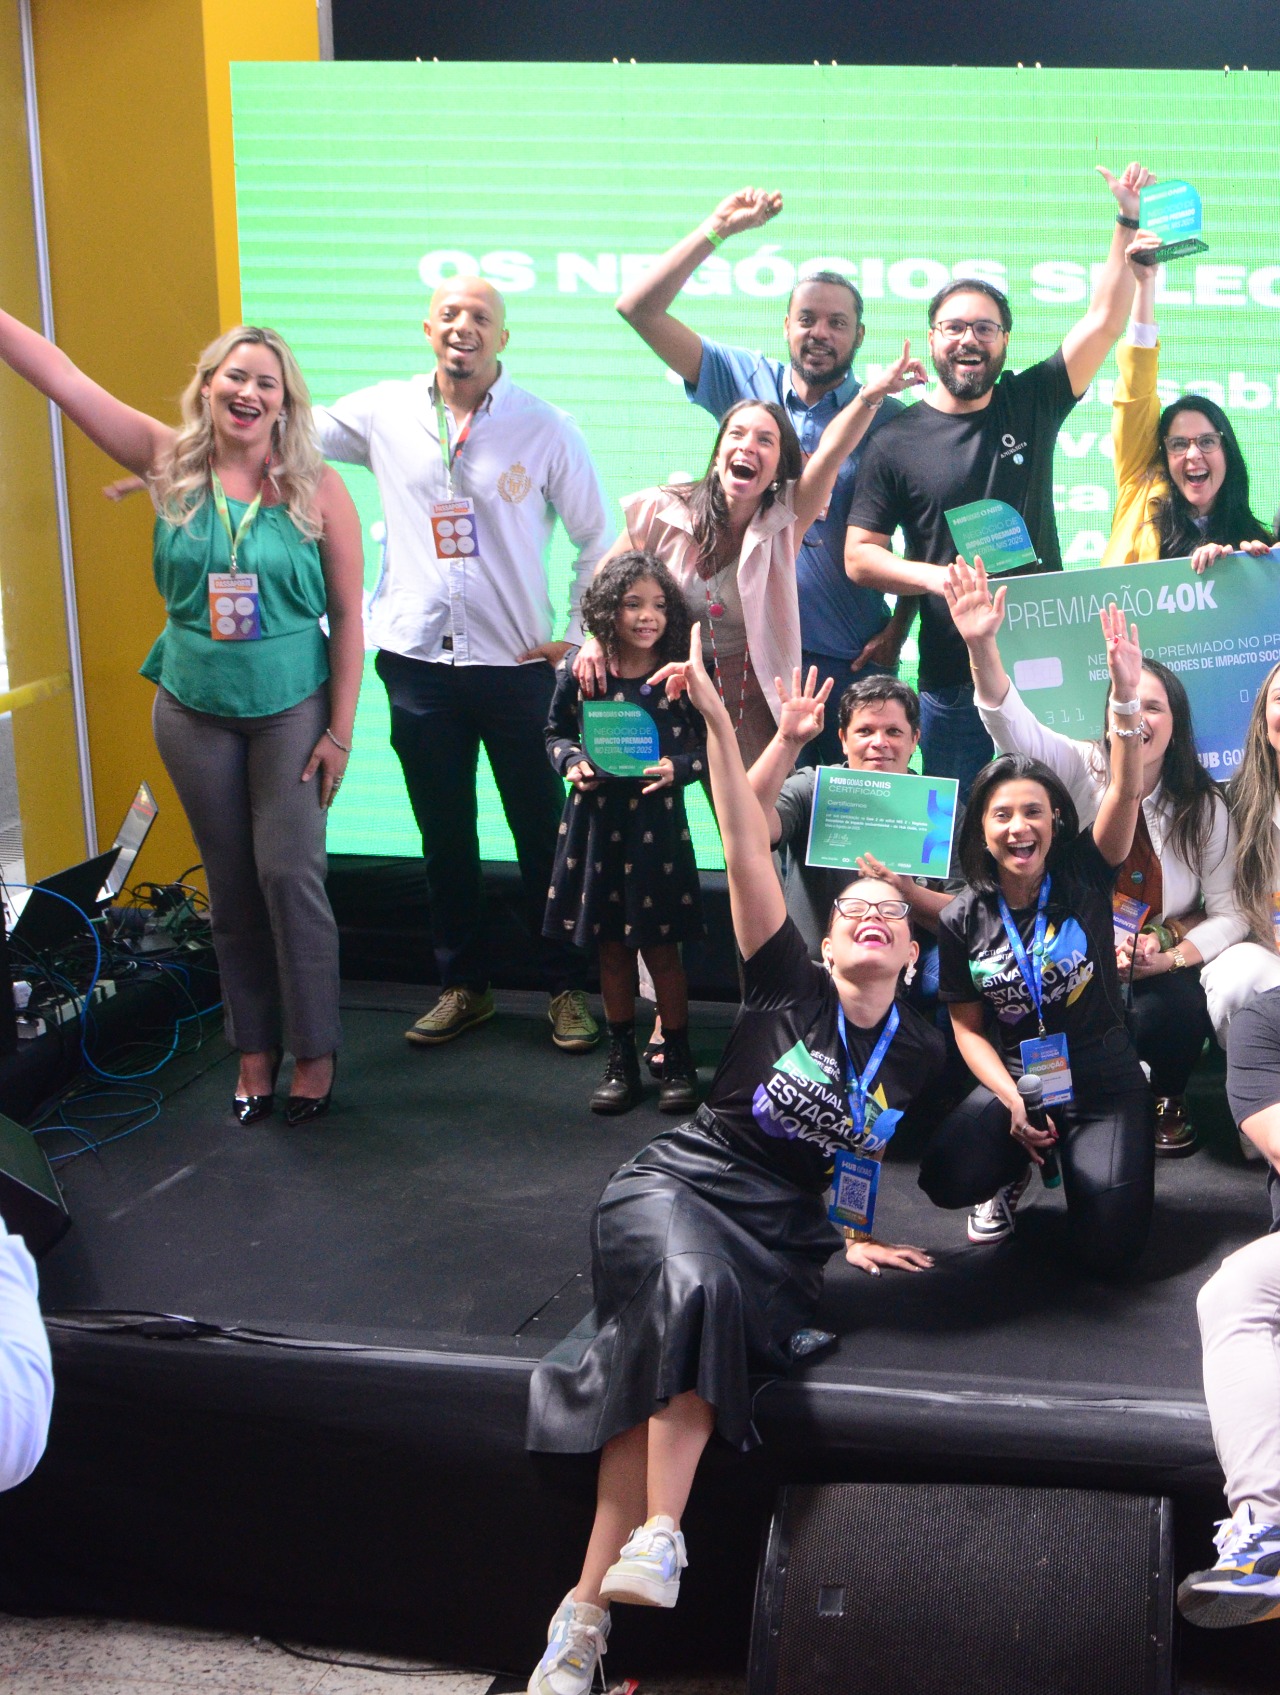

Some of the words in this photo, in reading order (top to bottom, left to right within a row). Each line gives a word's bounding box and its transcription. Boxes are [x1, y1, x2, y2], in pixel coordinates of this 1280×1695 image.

[419, 250, 536, 293] OS
[1008, 535, 1023, 546] 2025
[1007, 585, 1153, 631] PREMIAÇÃO
[1156, 580, 1218, 614] 40K
[1158, 639, 1234, 658] PREMIADO
[1238, 636, 1260, 649] NO
[1201, 656, 1214, 669] DE
[1215, 652, 1258, 668] IMPACTO
[593, 736, 621, 745] IMPACTO
[621, 736, 653, 744] PREMIADO
[636, 746, 653, 754] 2025
[1197, 751, 1220, 769] UB
[828, 785, 891, 798] CERTIFICADO
[871, 780, 892, 790] NIIS
[1056, 949, 1087, 978] DA
[982, 967, 1021, 988] ESTIVA
[1029, 1061, 1065, 1073] PRODUÇÃO
[781, 1059, 844, 1113] FESTIVAL
[756, 1093, 849, 1158] INOVAÇ
[841, 1160, 857, 1172] HUB
